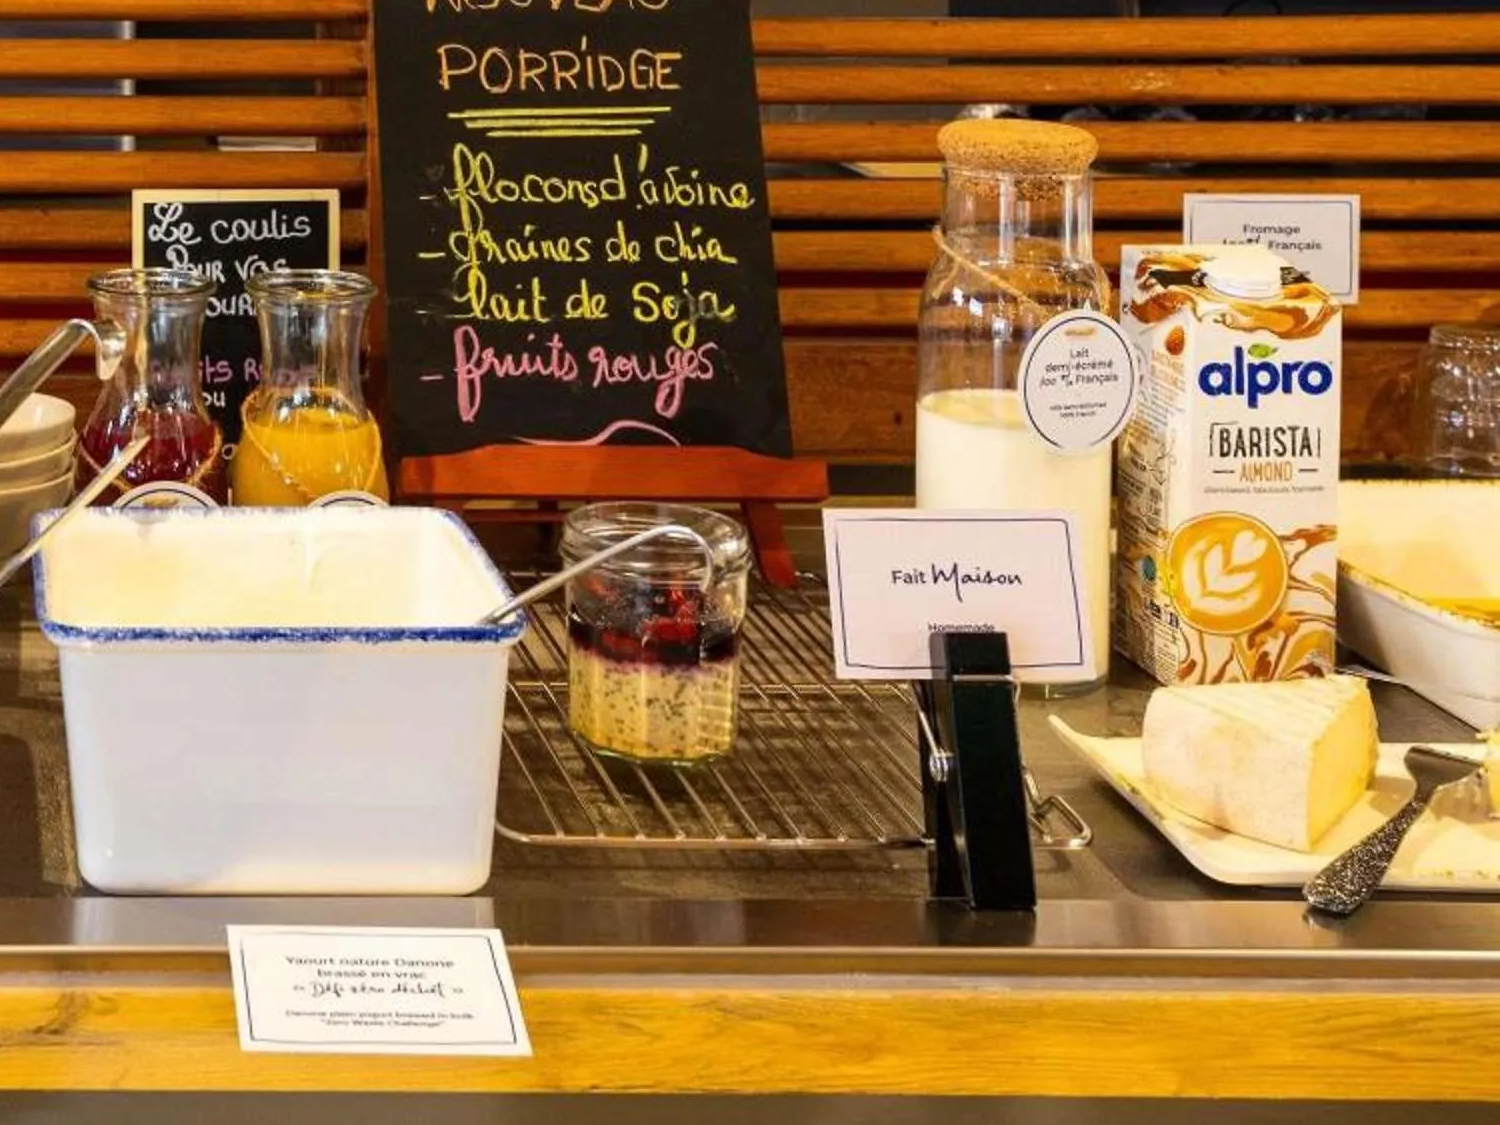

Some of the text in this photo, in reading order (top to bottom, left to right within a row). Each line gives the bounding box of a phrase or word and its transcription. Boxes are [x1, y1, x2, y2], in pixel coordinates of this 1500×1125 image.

[148, 202, 313, 246] Le coulis
[1243, 223, 1301, 237] Fromage
[606, 220, 641, 263] de
[654, 220, 739, 264] chia
[1267, 239, 1323, 252] Français
[466, 268, 550, 323] lait
[565, 278, 610, 319] de
[1069, 347, 1090, 359] Lait
[453, 325, 719, 422] fruits rouges
[1075, 374, 1119, 386] Français
[1198, 345, 1333, 409] alpro
[1219, 426, 1313, 458] BARISTA
[1240, 461, 1293, 482] ALMOND
[891, 562, 1023, 603] Fait Maison
[285, 956, 456, 968] Yaourt nature Danone
